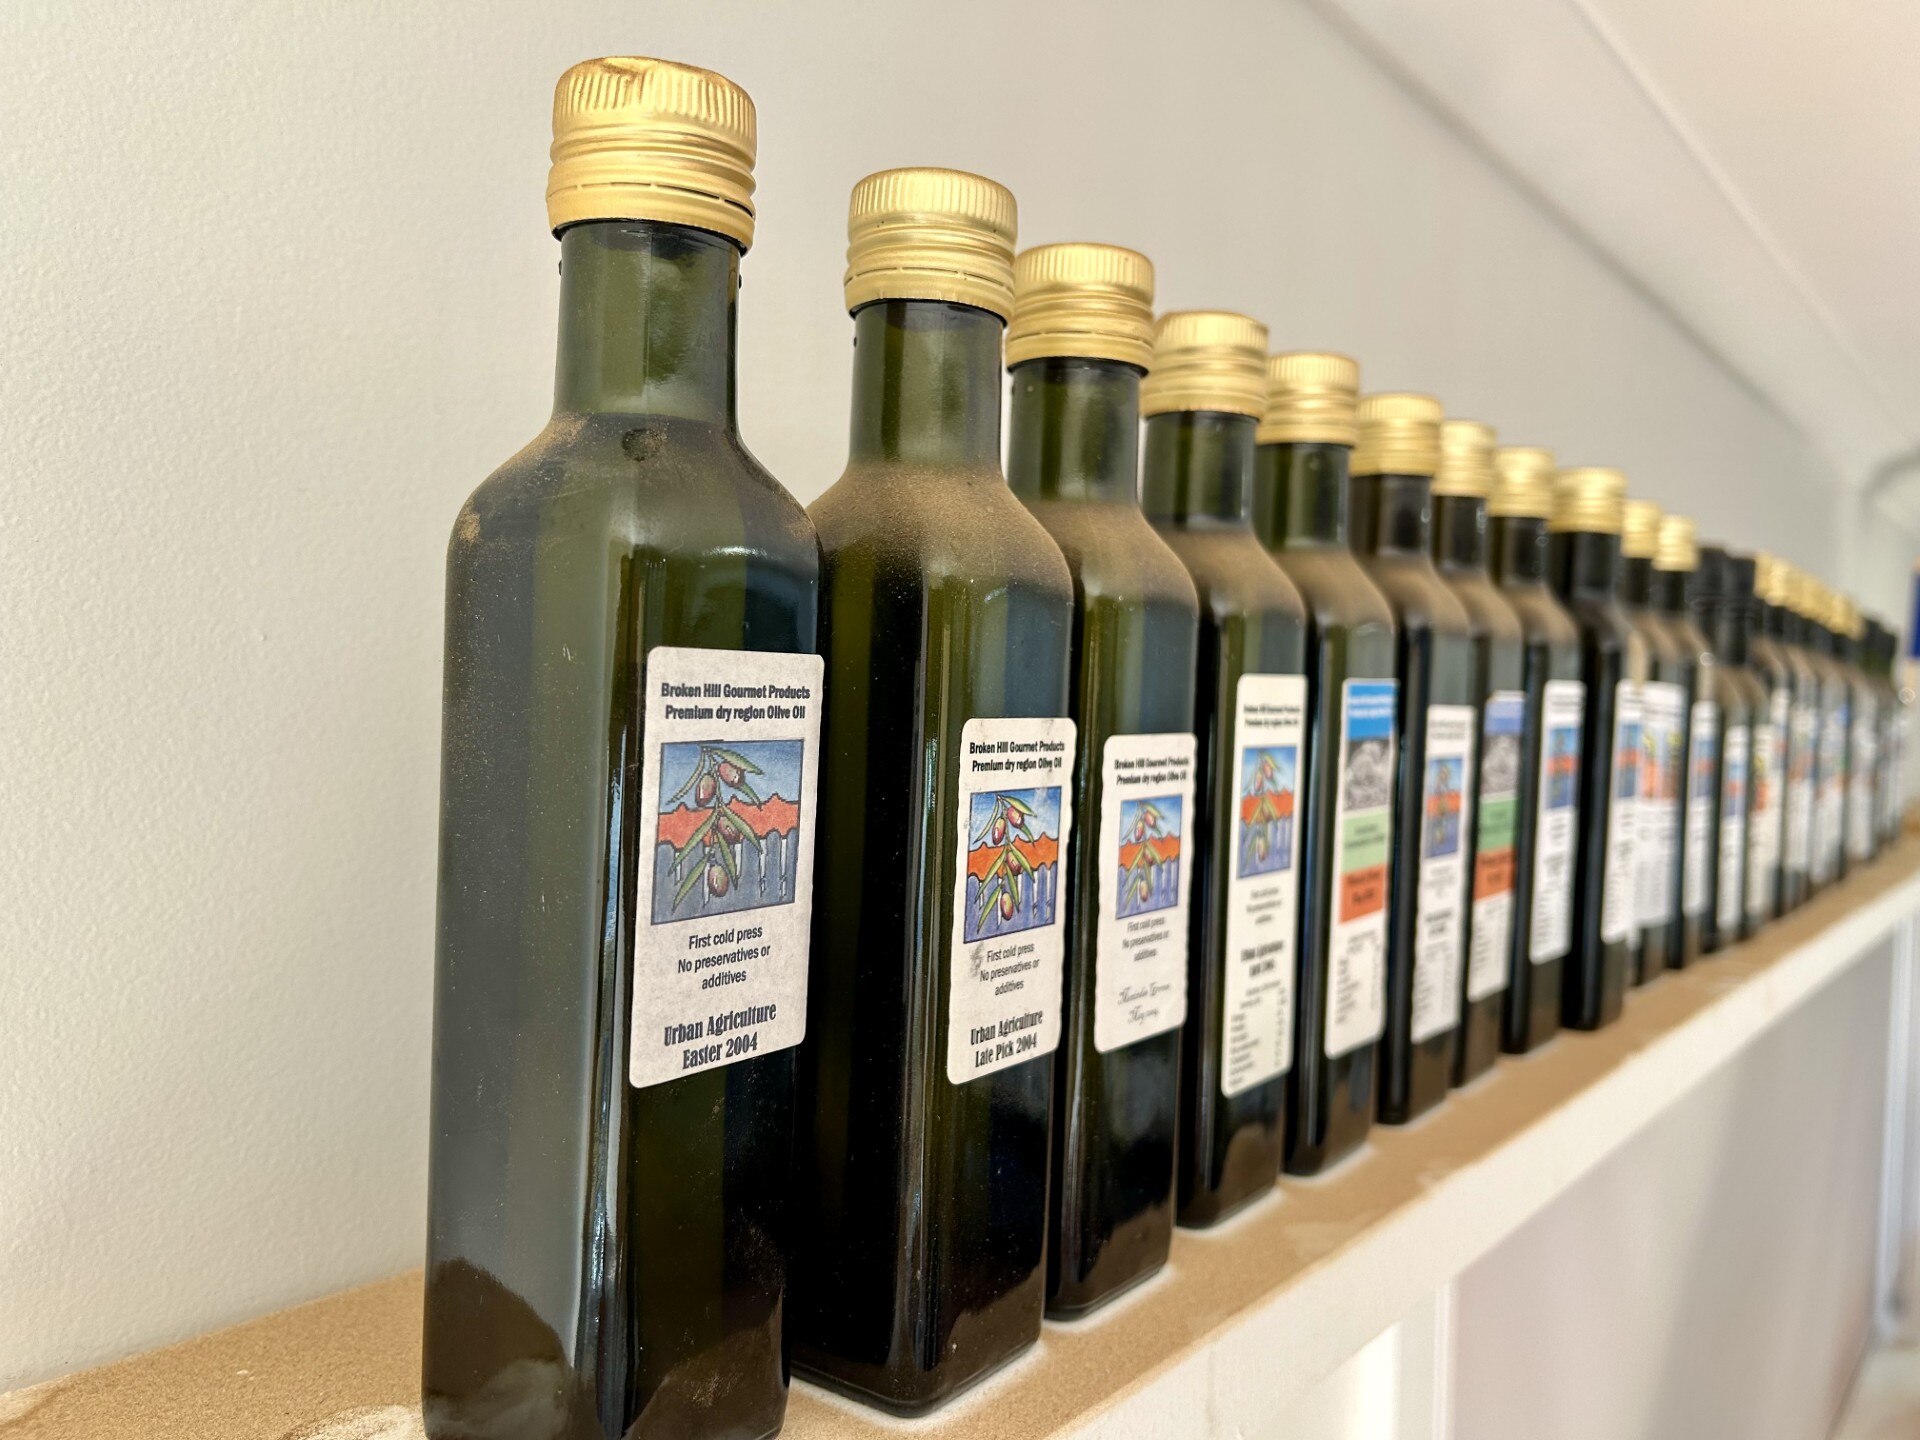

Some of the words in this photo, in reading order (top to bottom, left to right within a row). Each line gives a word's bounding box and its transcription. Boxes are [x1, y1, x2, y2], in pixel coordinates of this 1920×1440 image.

[662, 683, 701, 697] Broken
[704, 684, 721, 697] Hill
[723, 684, 766, 698] Gourmet
[768, 685, 810, 699] Products
[666, 705, 713, 719] Premium
[716, 706, 731, 722] dry
[734, 705, 764, 721] region
[767, 706, 790, 718] Olive
[793, 706, 805, 718] Oil
[970, 742, 995, 754] Broken
[997, 742, 1008, 753] Hill
[1010, 741, 1038, 752] Gourmet
[1040, 741, 1064, 752] Products
[972, 759, 1003, 772] Premium
[1005, 759, 1015, 772] dry
[1017, 758, 1036, 771] region
[1038, 758, 1052, 768] Olive
[1115, 759, 1134, 769] Broken
[689, 935, 711, 949] First
[714, 930, 734, 945] cold
[737, 926, 762, 944] press
[678, 959, 692, 973] No
[695, 948, 758, 972] preservatives
[761, 946, 770, 956] or
[987, 950, 1002, 962] First
[1003, 946, 1016, 960] cold
[1017, 944, 1034, 957] press
[702, 970, 747, 989] additives
[980, 970, 989, 982] No
[1033, 959, 1040, 968] or
[995, 980, 1024, 995] additives
[664, 1021, 703, 1046] Urban
[707, 1003, 776, 1036] Agriculture
[971, 1025, 996, 1045] Urban
[998, 1010, 1043, 1036] Agriculture
[683, 1044, 722, 1069] Easter
[726, 1032, 758, 1058] 2004
[976, 1048, 993, 1067] Late
[996, 1040, 1013, 1061] Pick
[1016, 1033, 1037, 1053] 2004
